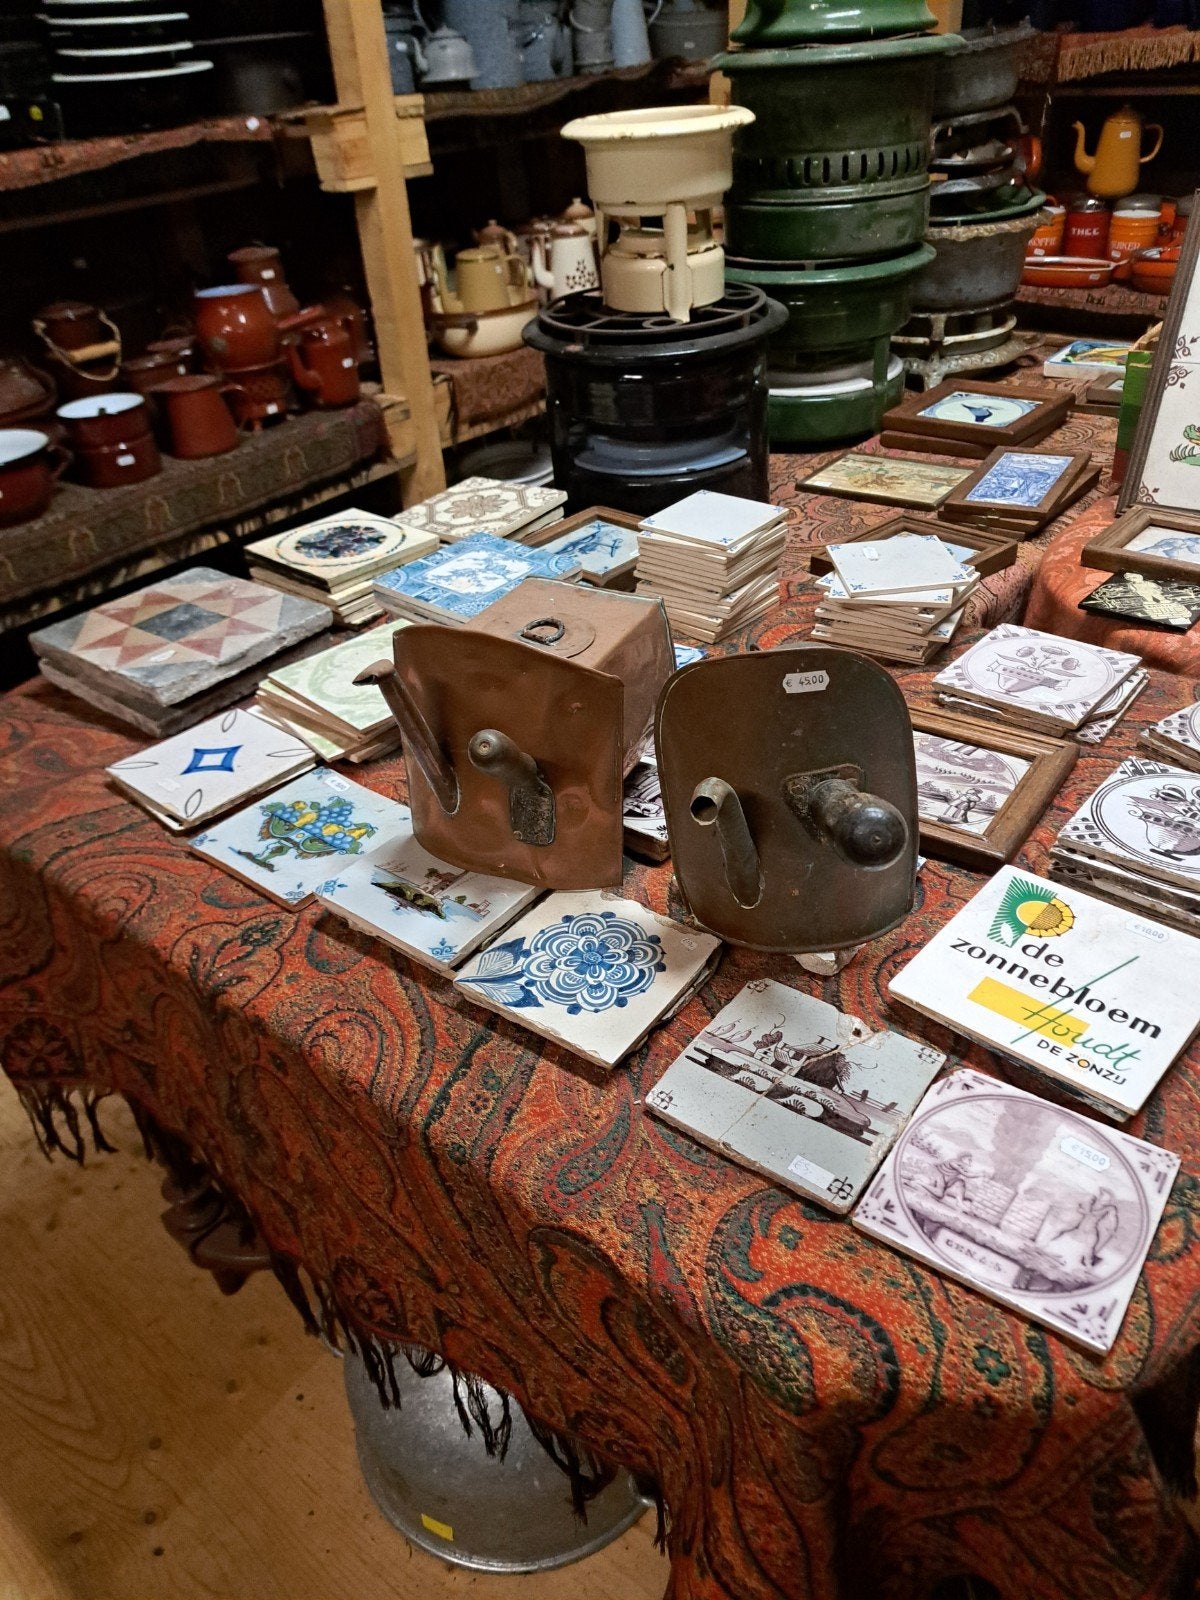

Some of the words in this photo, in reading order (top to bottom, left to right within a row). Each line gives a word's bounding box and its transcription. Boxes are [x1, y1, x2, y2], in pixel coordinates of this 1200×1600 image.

[1071, 227, 1100, 236] THEE
[785, 679, 793, 688] €
[1021, 943, 1064, 967] de
[950, 937, 1162, 1039] zonnebloem
[1010, 956, 1142, 1072] Houdt
[1036, 1039, 1062, 1057] DE
